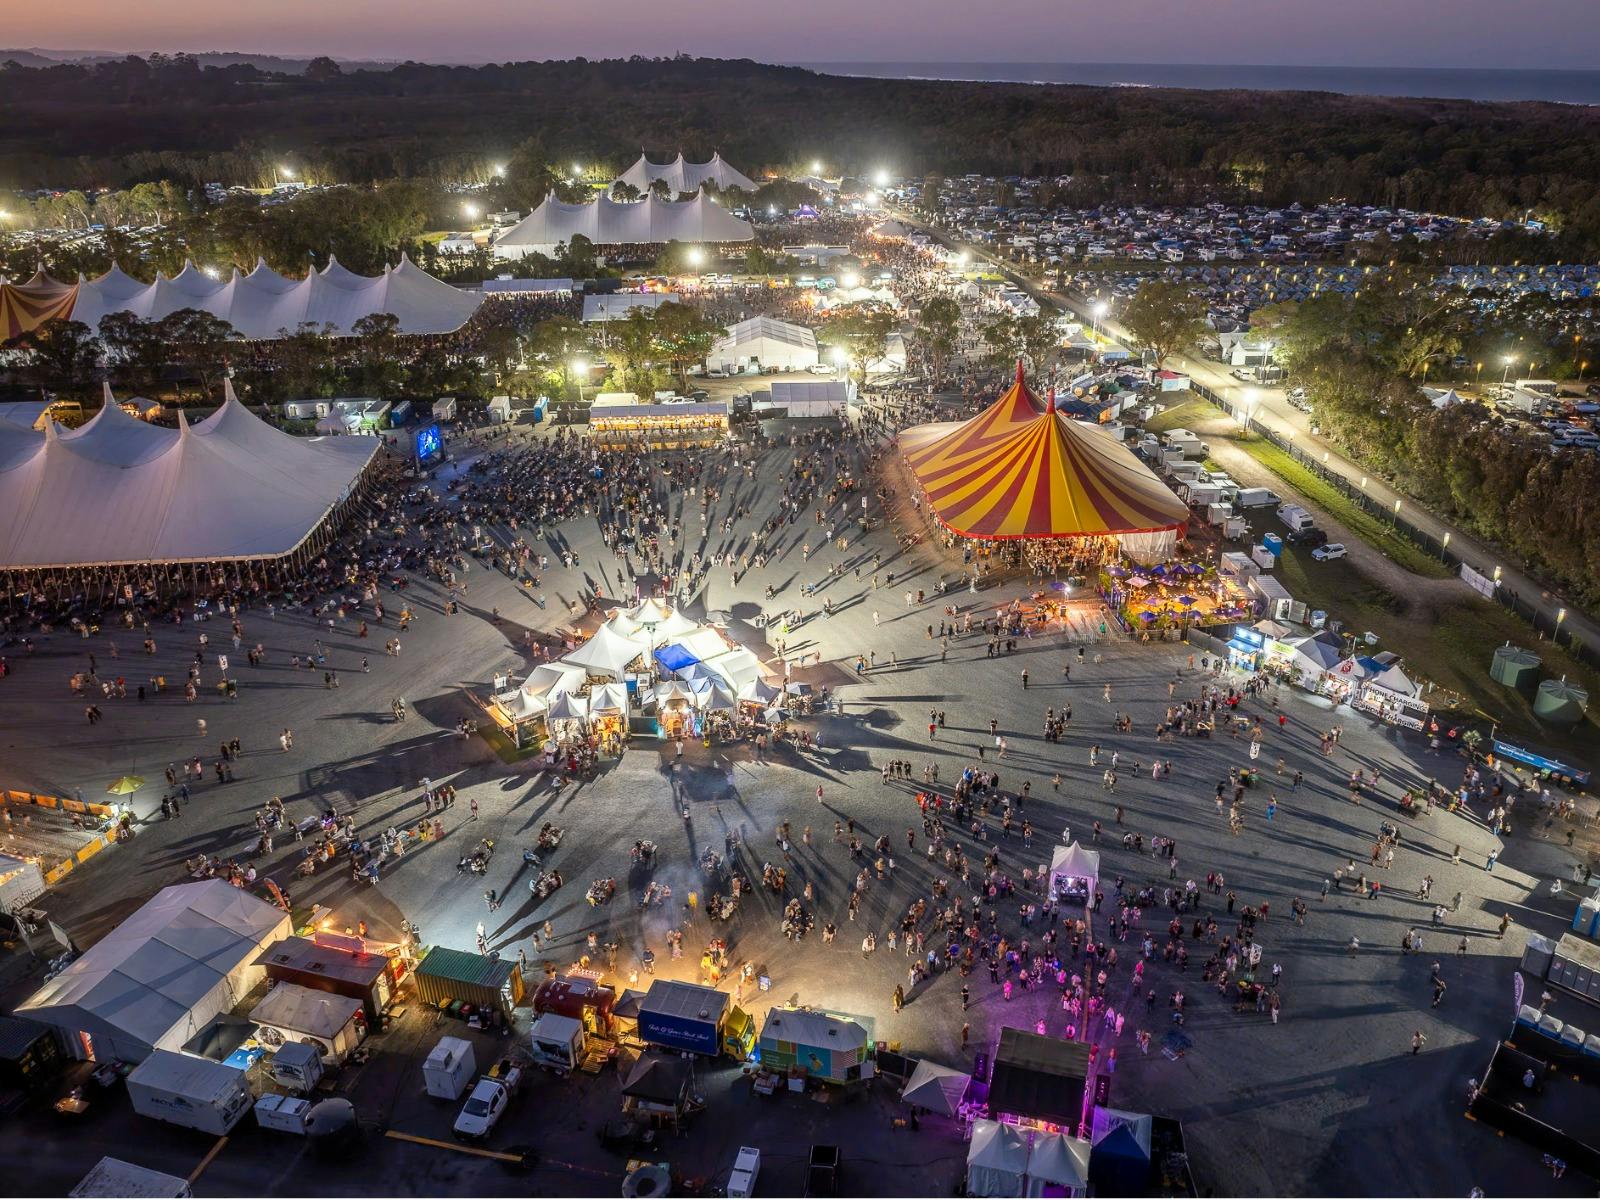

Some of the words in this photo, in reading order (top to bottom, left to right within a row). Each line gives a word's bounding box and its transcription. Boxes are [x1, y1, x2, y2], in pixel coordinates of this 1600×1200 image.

[1389, 694, 1427, 712] CHARGING
[1361, 704, 1382, 718] PHON
[1384, 713, 1423, 730] CHARGING
